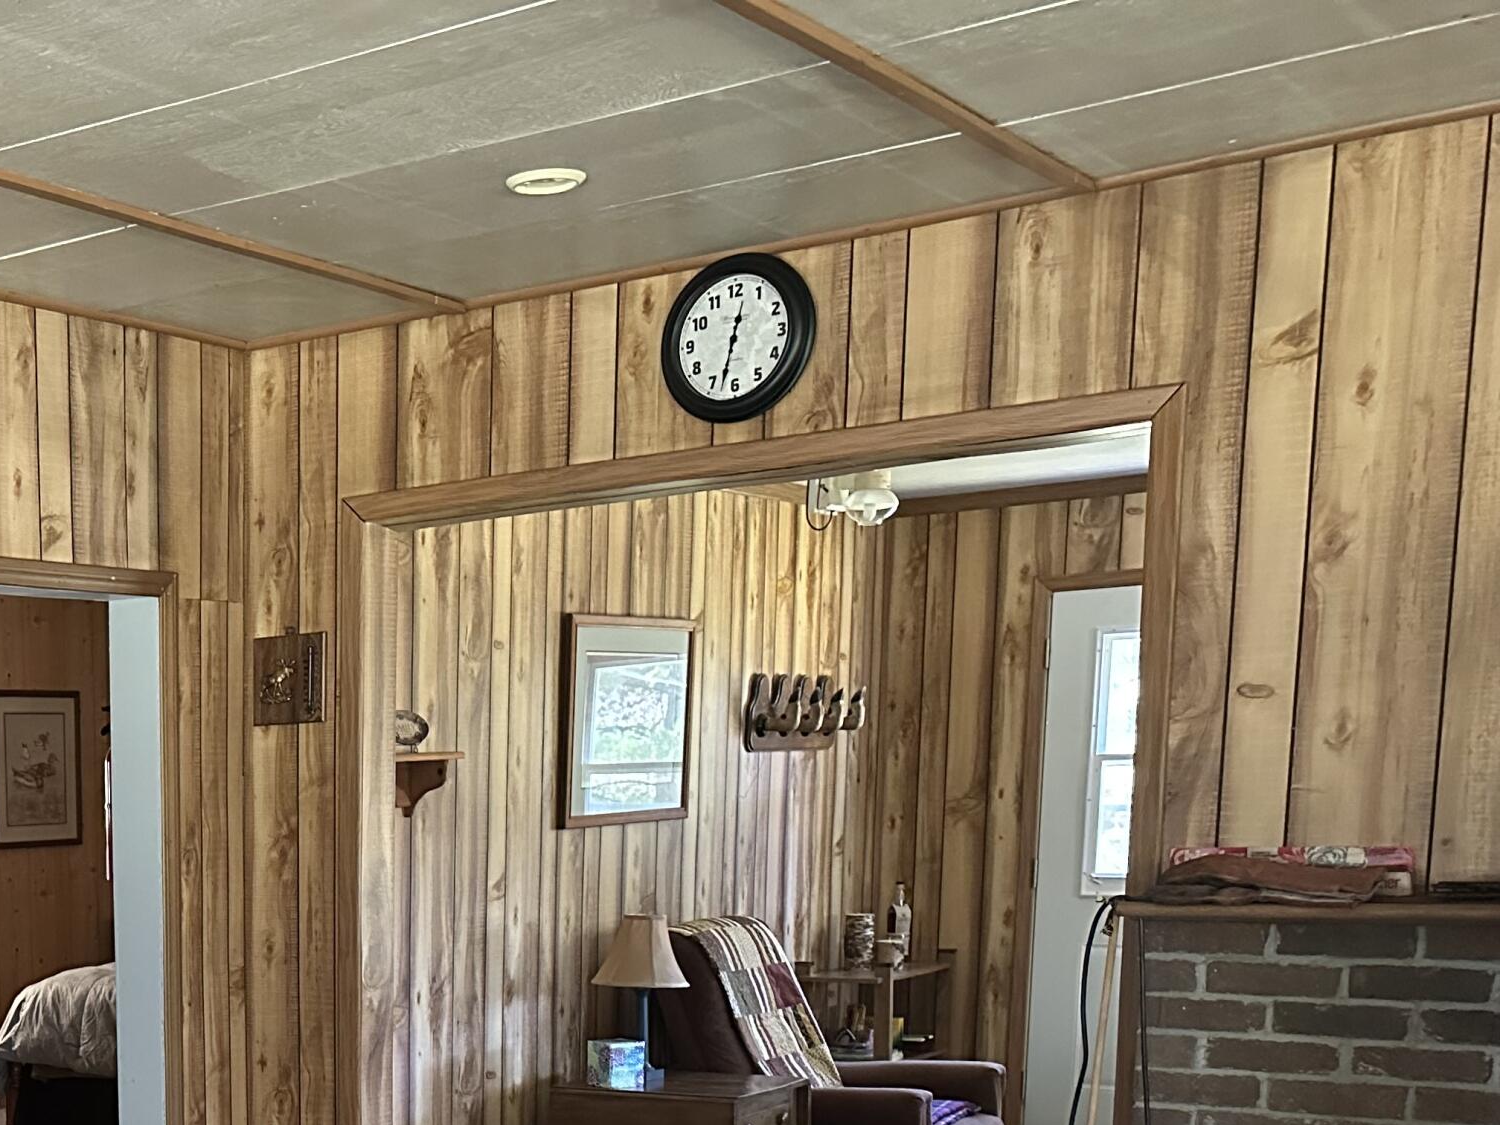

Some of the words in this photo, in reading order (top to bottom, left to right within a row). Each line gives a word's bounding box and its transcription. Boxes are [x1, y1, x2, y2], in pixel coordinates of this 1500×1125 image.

[727, 283, 744, 299] 12
[755, 286, 762, 300] 1
[708, 295, 721, 310] 11
[771, 301, 780, 316] 2
[692, 316, 708, 332] 10
[777, 322, 787, 336] 3
[686, 340, 695, 354] 9
[769, 346, 780, 360] 4
[692, 361, 701, 375] 8
[754, 367, 762, 381] 5
[708, 375, 717, 390] 7
[730, 378, 740, 392] 6
